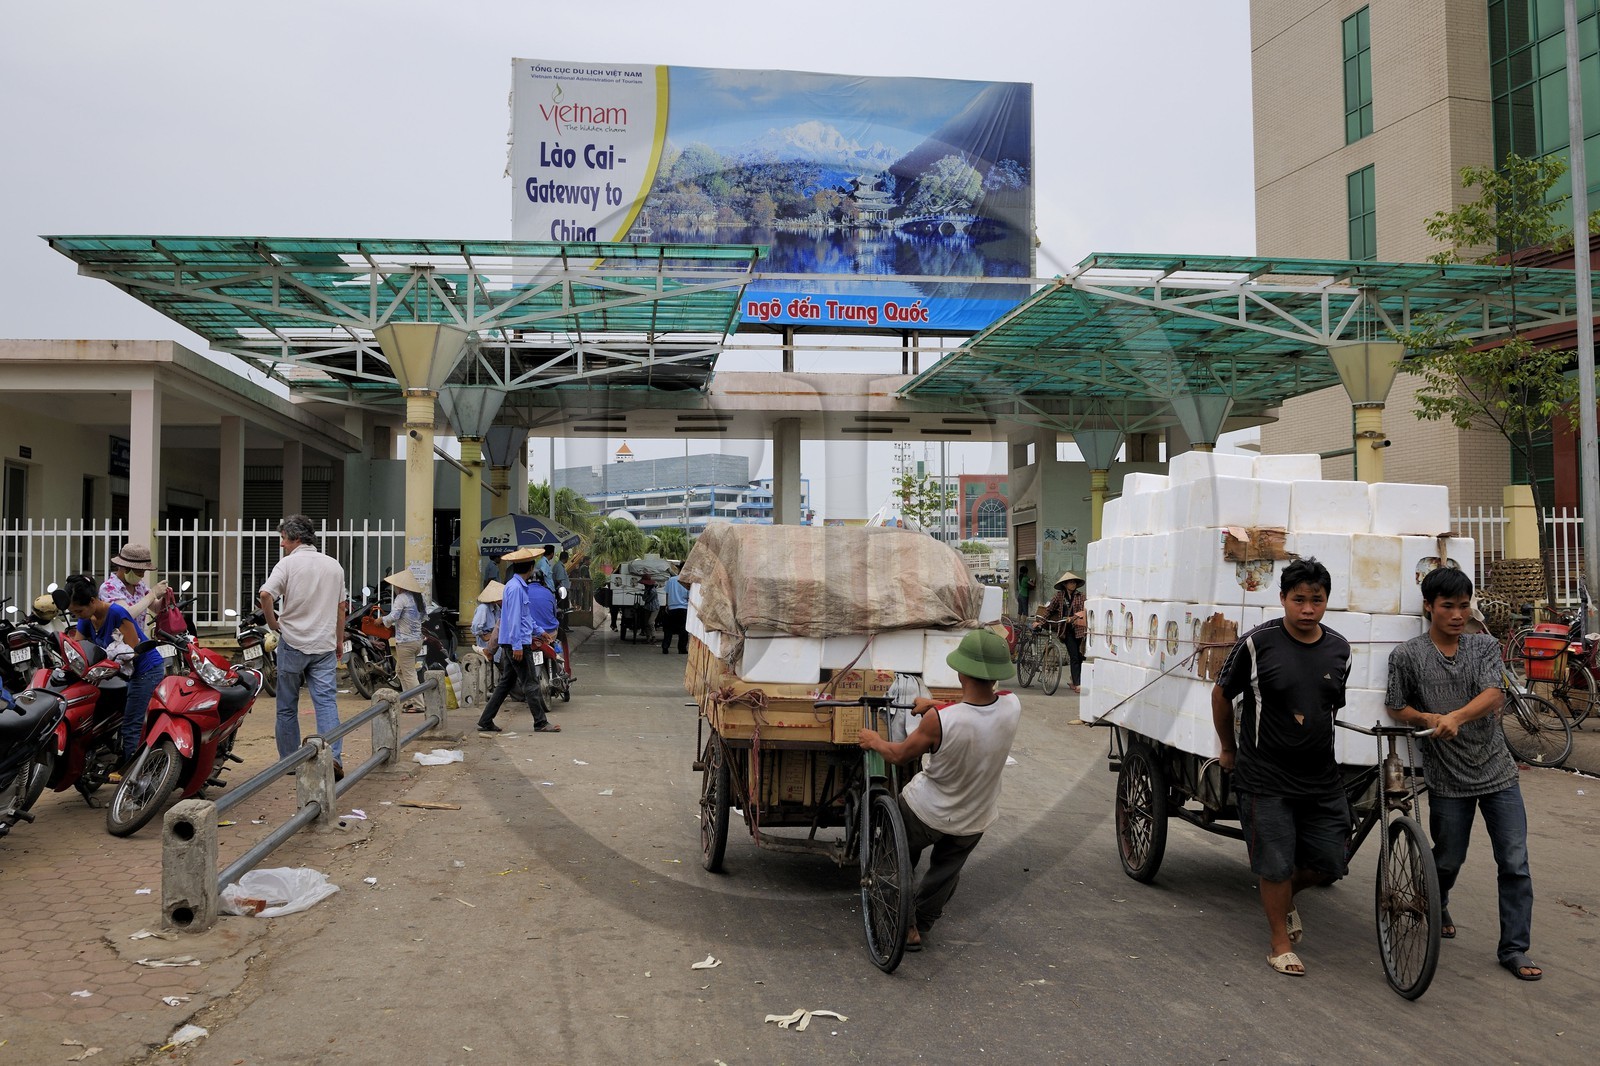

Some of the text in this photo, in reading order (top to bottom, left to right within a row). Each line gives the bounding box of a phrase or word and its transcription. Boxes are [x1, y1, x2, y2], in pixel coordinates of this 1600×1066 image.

[554, 67, 571, 76] CỤC
[586, 69, 603, 77] LỊCH
[605, 69, 622, 78] VIỆT
[579, 124, 603, 132] hidden
[540, 141, 576, 168] Lào
[525, 177, 623, 212] Gateway to
[748, 296, 930, 325] ngõ đến Trung Quốc
